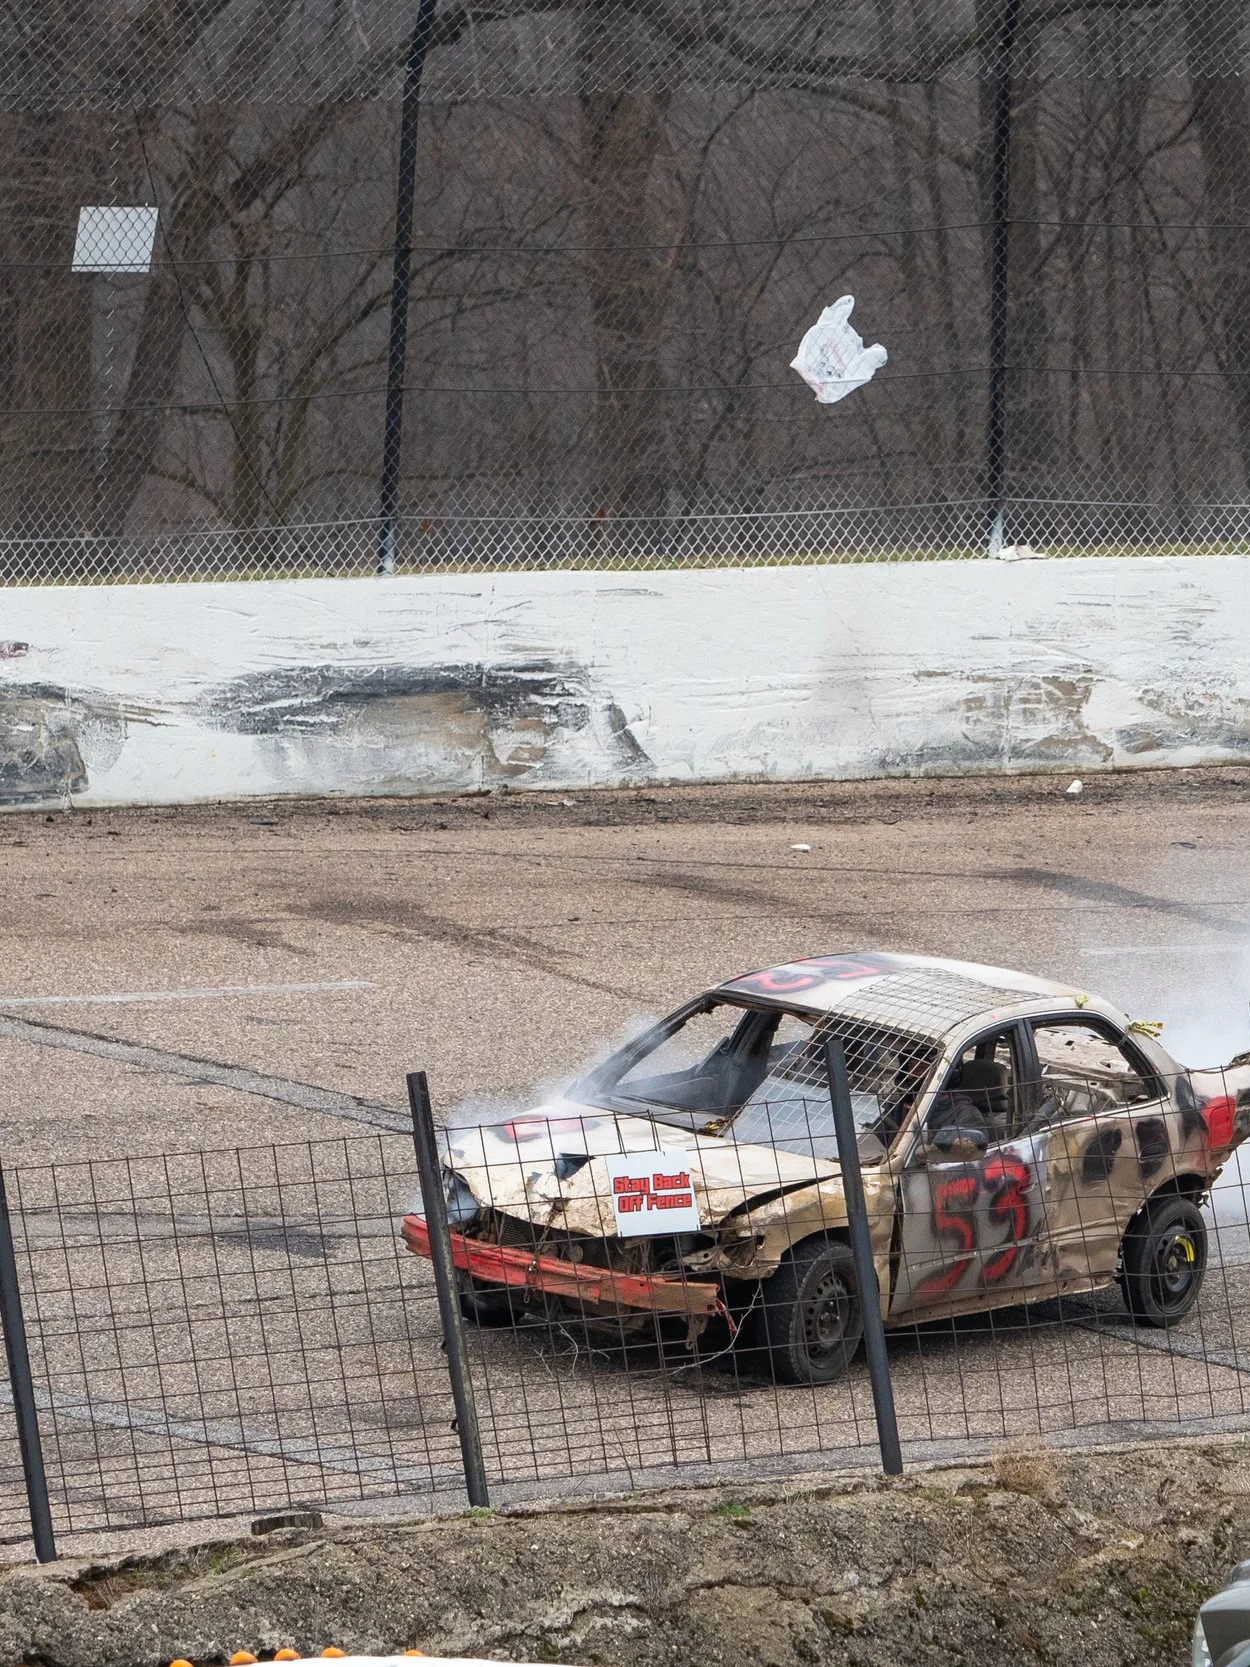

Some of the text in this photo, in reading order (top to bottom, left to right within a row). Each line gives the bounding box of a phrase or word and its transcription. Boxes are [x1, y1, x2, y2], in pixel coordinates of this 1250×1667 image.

[614, 1171, 691, 1195] Stay Back
[618, 1193, 692, 1213] Off Fence
[910, 1157, 1029, 1298] 53
